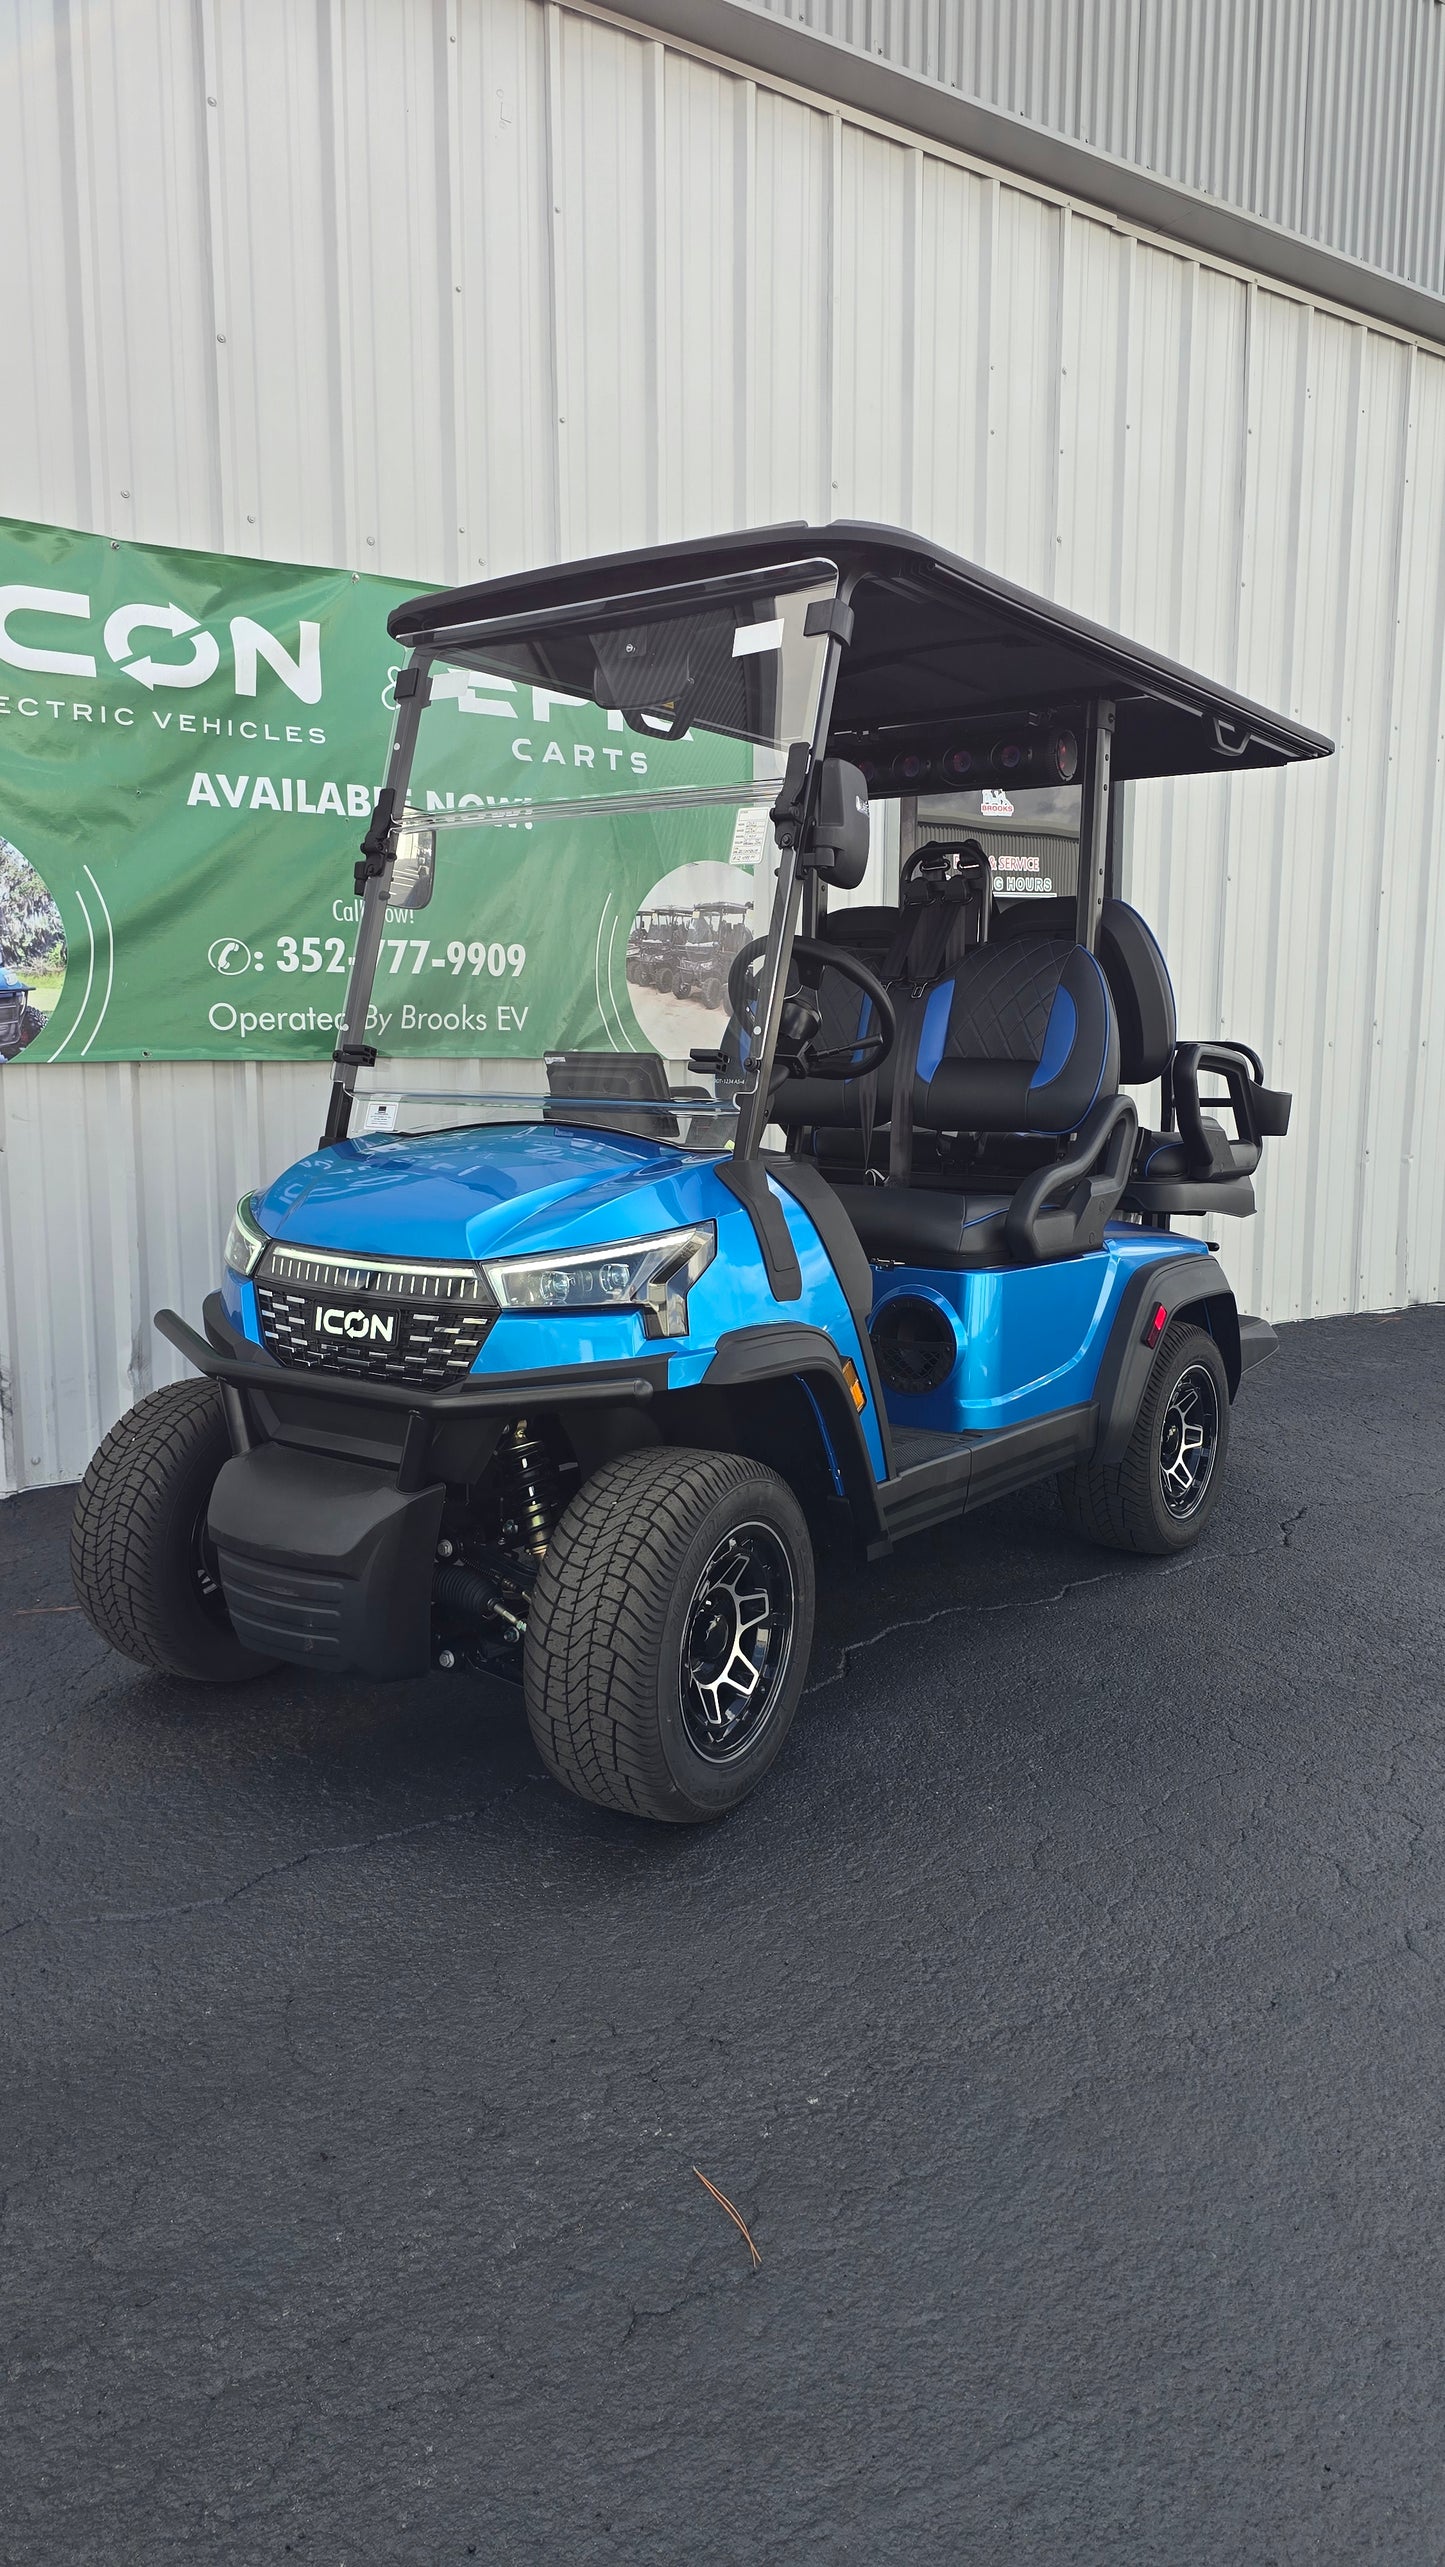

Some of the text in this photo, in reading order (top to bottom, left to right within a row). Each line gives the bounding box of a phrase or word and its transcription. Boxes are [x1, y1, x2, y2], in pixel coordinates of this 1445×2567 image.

[153, 711, 327, 744] VEHICLES
[512, 738, 648, 774] CARTS
[187, 772, 411, 818] AVAILAB
[998, 856, 1039, 872] SERVICE
[1006, 876, 1052, 892] HOURS
[384, 908, 414, 924] ow!
[364, 1005, 393, 1036] By
[401, 1005, 487, 1033] Brooks
[497, 1006, 528, 1032] EV
[315, 1306, 394, 1342] ICON
